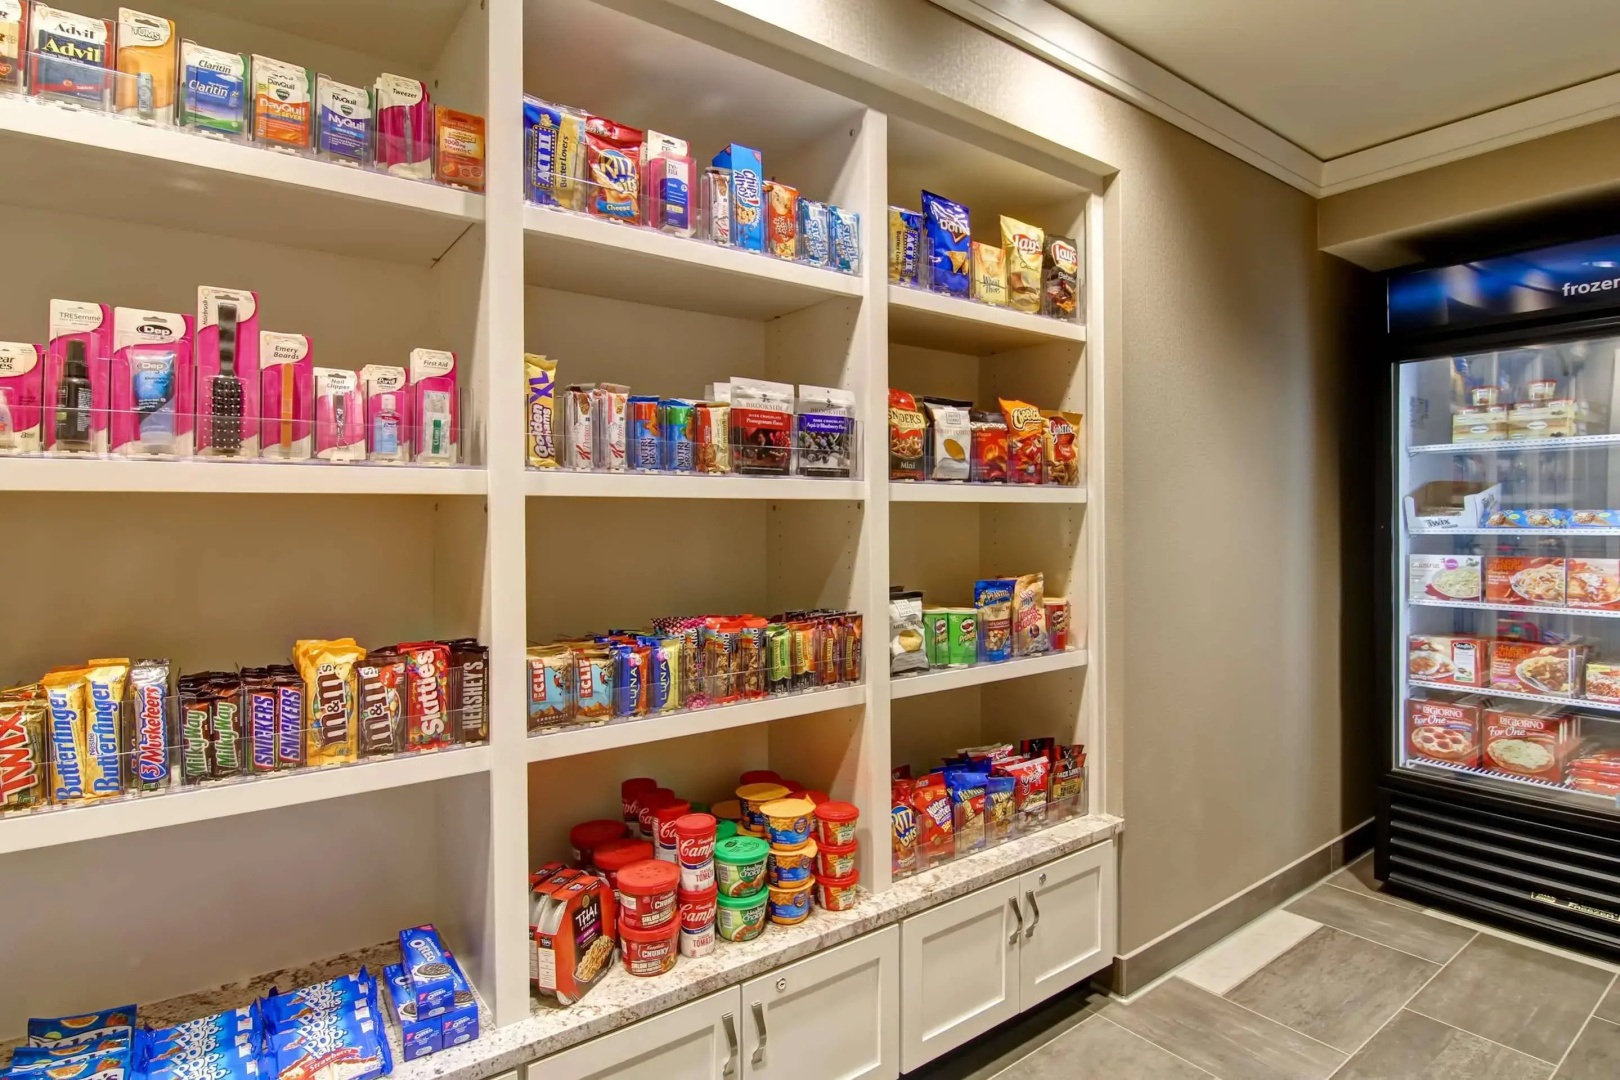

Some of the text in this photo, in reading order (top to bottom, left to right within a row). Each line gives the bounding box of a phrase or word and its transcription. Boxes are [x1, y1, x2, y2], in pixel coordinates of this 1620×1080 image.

[54, 24, 95, 40] Advil
[132, 27, 161, 41] TUMS
[42, 38, 101, 63] Advil
[198, 59, 232, 75] Claritin
[188, 79, 228, 98] Claritin
[392, 88, 417, 98] Tweezer
[260, 98, 305, 116] DayQuil
[328, 113, 366, 132] NyQuil
[560, 136, 569, 160] Lovers
[606, 204, 631, 212] Cheese
[810, 220, 828, 256] TREATS
[842, 224, 858, 260] TREATS
[60, 312, 101, 322] TRESemmé
[143, 325, 171, 337] Dep
[0, 355, 16, 364] ear
[274, 345, 298, 354] Emery
[274, 352, 300, 360] Boards
[0, 362, 13, 371] es
[142, 362, 164, 371] Dep
[423, 358, 448, 368] First Aid
[326, 382, 350, 392] Clipper
[331, 378, 345, 386] Nail
[528, 370, 555, 403] XL
[746, 402, 782, 410] BROOKSIDE
[532, 403, 549, 459] Golden
[542, 408, 556, 458] Grahams
[641, 437, 649, 465] NUTRI
[648, 438, 656, 466] GRAIN
[676, 442, 684, 468] NUTRI
[1424, 518, 1450, 528] Twix
[722, 632, 730, 654] KIND
[532, 659, 545, 692] CLIF
[579, 658, 592, 689] CLIF
[660, 661, 668, 701] LUNA
[416, 650, 444, 735] Skittles
[462, 661, 484, 730] HERSHEY'S
[630, 667, 638, 708] LUNA
[1412, 714, 1446, 724] For One
[1423, 706, 1463, 718] DIGIORNO
[140, 686, 163, 777] 3 Musketeers
[254, 696, 274, 766] SNICKERS
[280, 689, 300, 760] SNICKERS
[1488, 726, 1526, 736] For One
[1500, 717, 1544, 730] DIGIORNO
[51, 690, 84, 800] Butterfinger
[92, 680, 120, 793] Butterfinger
[926, 798, 947, 818] Nutter
[934, 804, 952, 824] Butter
[575, 902, 598, 928] THAI
[409, 940, 436, 962] OREO
[302, 1028, 344, 1056] Pop
[310, 1048, 352, 1072] Strawberry
